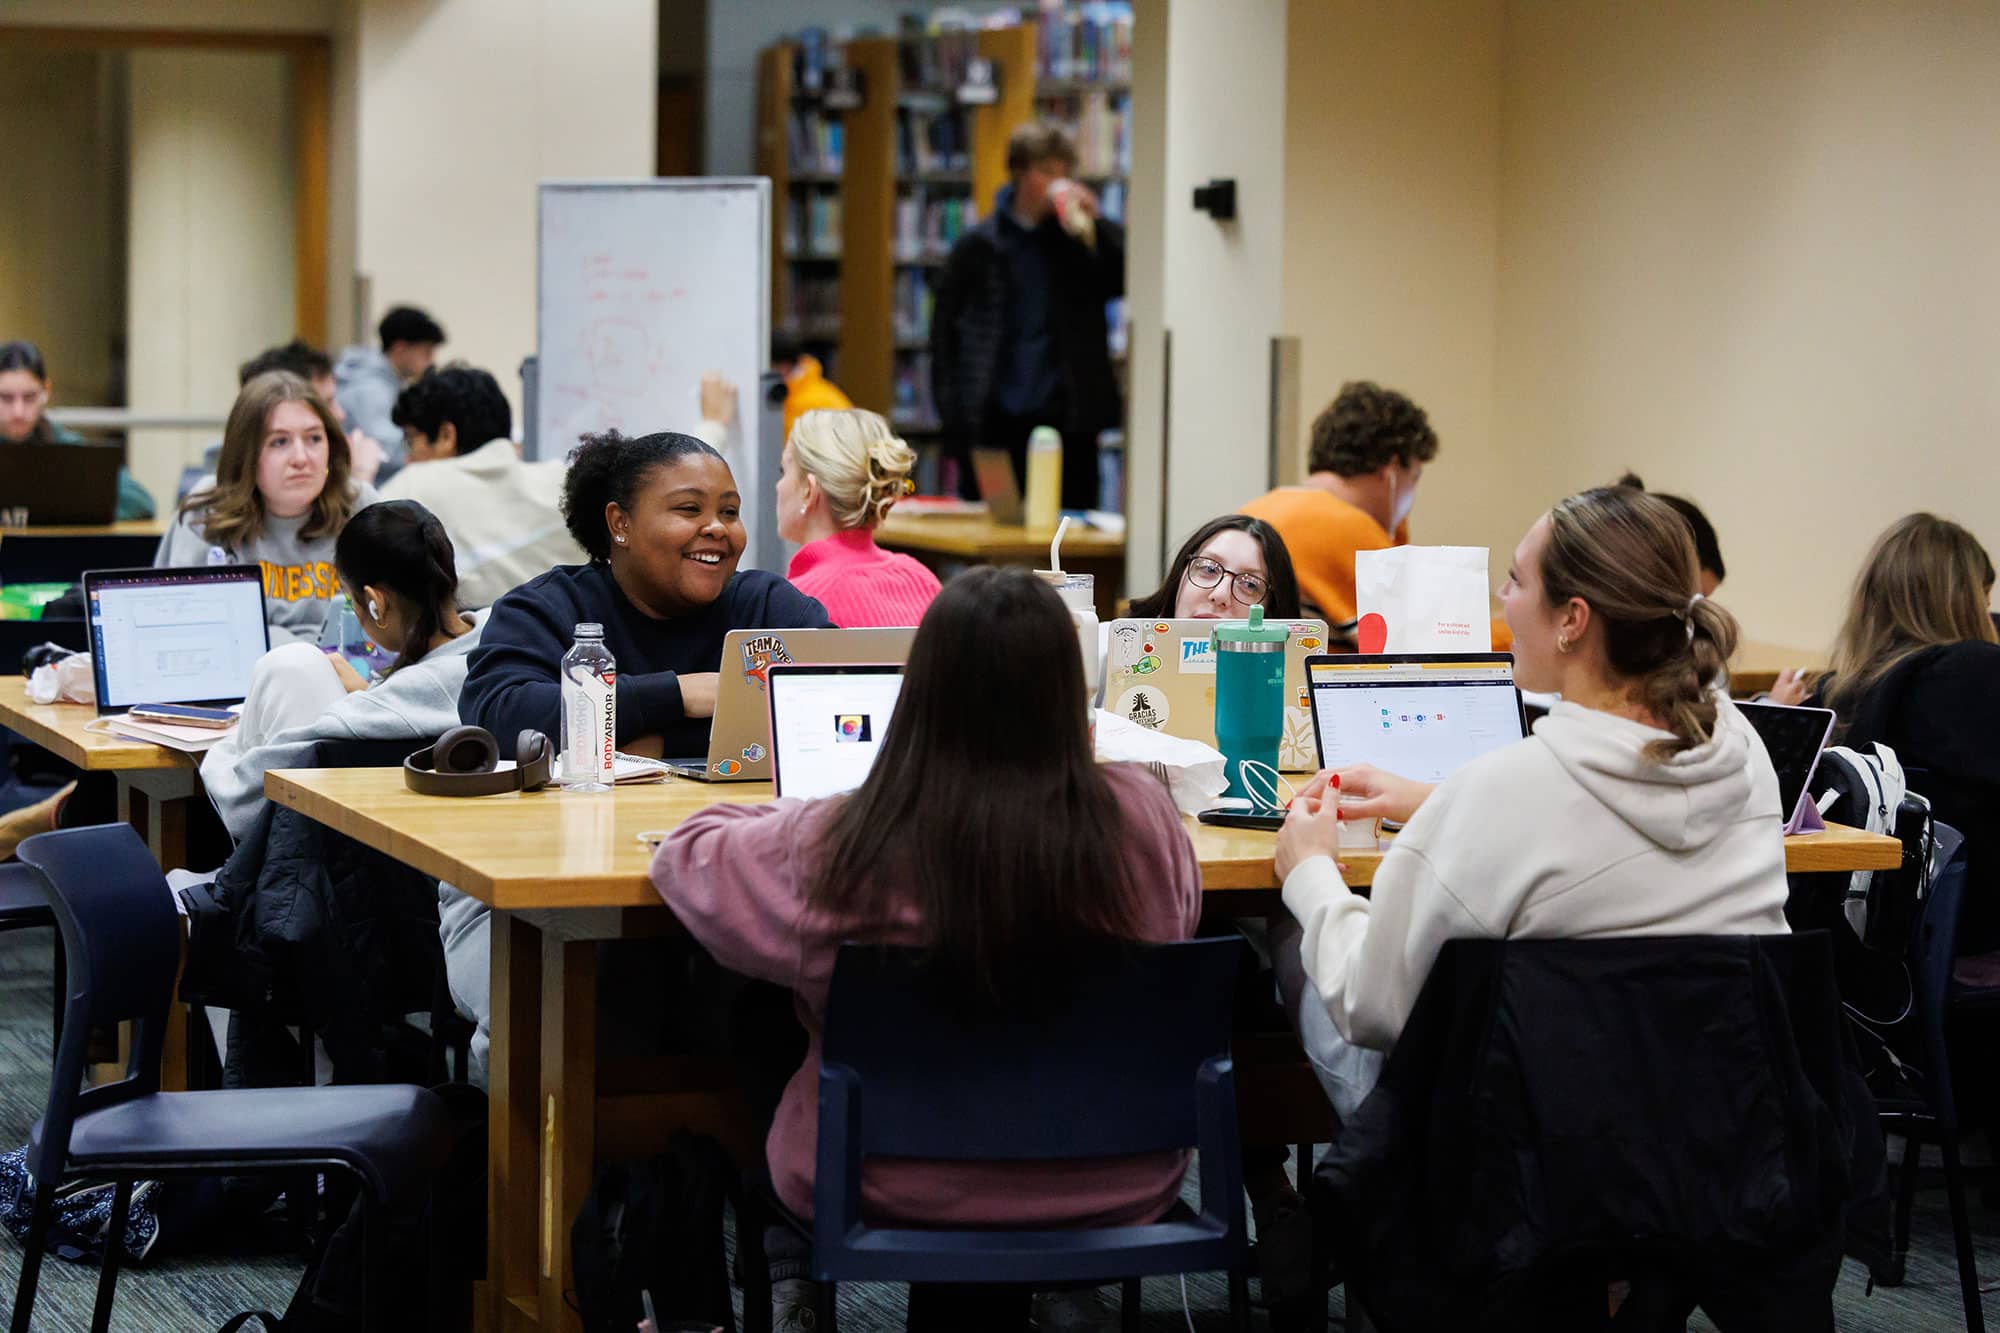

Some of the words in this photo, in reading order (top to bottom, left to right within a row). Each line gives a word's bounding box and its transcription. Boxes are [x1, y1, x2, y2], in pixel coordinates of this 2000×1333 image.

[746, 637, 772, 656] TEAM
[1183, 641, 1209, 660] THE
[1128, 709, 1157, 721] GRACIAS
[604, 694, 614, 770] BODYARMOR
